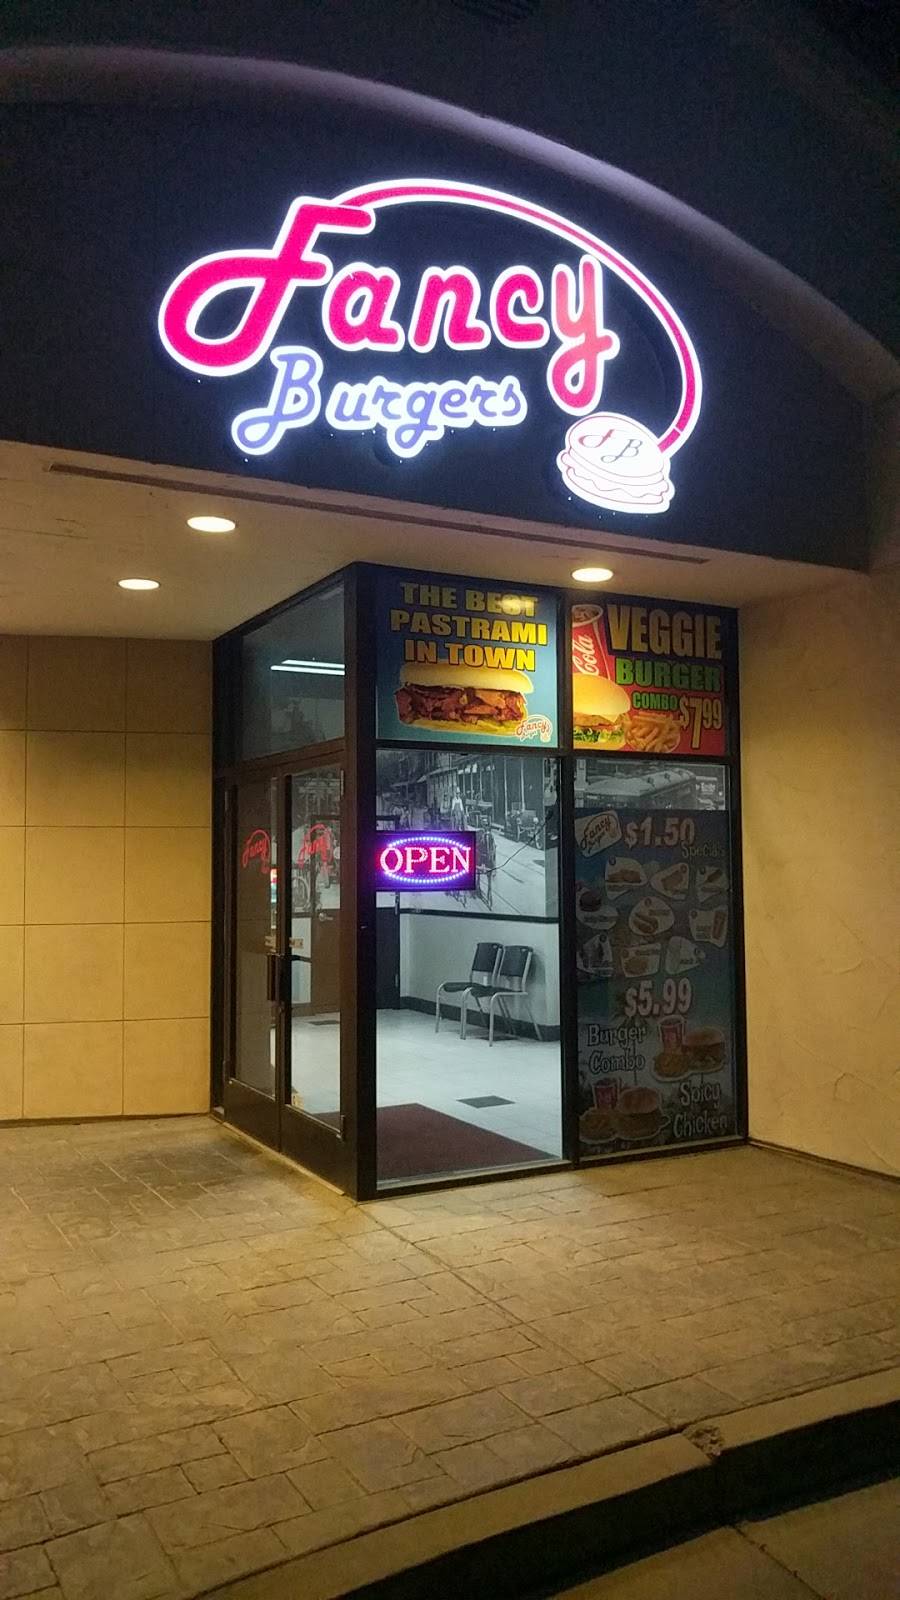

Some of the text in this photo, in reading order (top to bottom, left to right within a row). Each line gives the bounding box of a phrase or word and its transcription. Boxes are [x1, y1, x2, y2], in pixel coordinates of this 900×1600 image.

[159, 197, 619, 416] Fancy
[232, 346, 527, 457] Burgers
[401, 582, 537, 617] THE BEST
[390, 609, 548, 646] PASTRAMI
[606, 604, 722, 660] VEGGIE
[404, 639, 536, 672] IN TOWN
[572, 634, 599, 676] Cola
[615, 657, 721, 691] BURGER
[632, 692, 679, 711] COMBO
[624, 816, 695, 849] $1.50
[380, 847, 471, 873] OPEN
[624, 977, 692, 1017] $5.99
[587, 1023, 647, 1049] Burger
[589, 1049, 646, 1074] Combo
[679, 1080, 721, 1108] Spicy
[673, 1108, 728, 1138] Chicken
